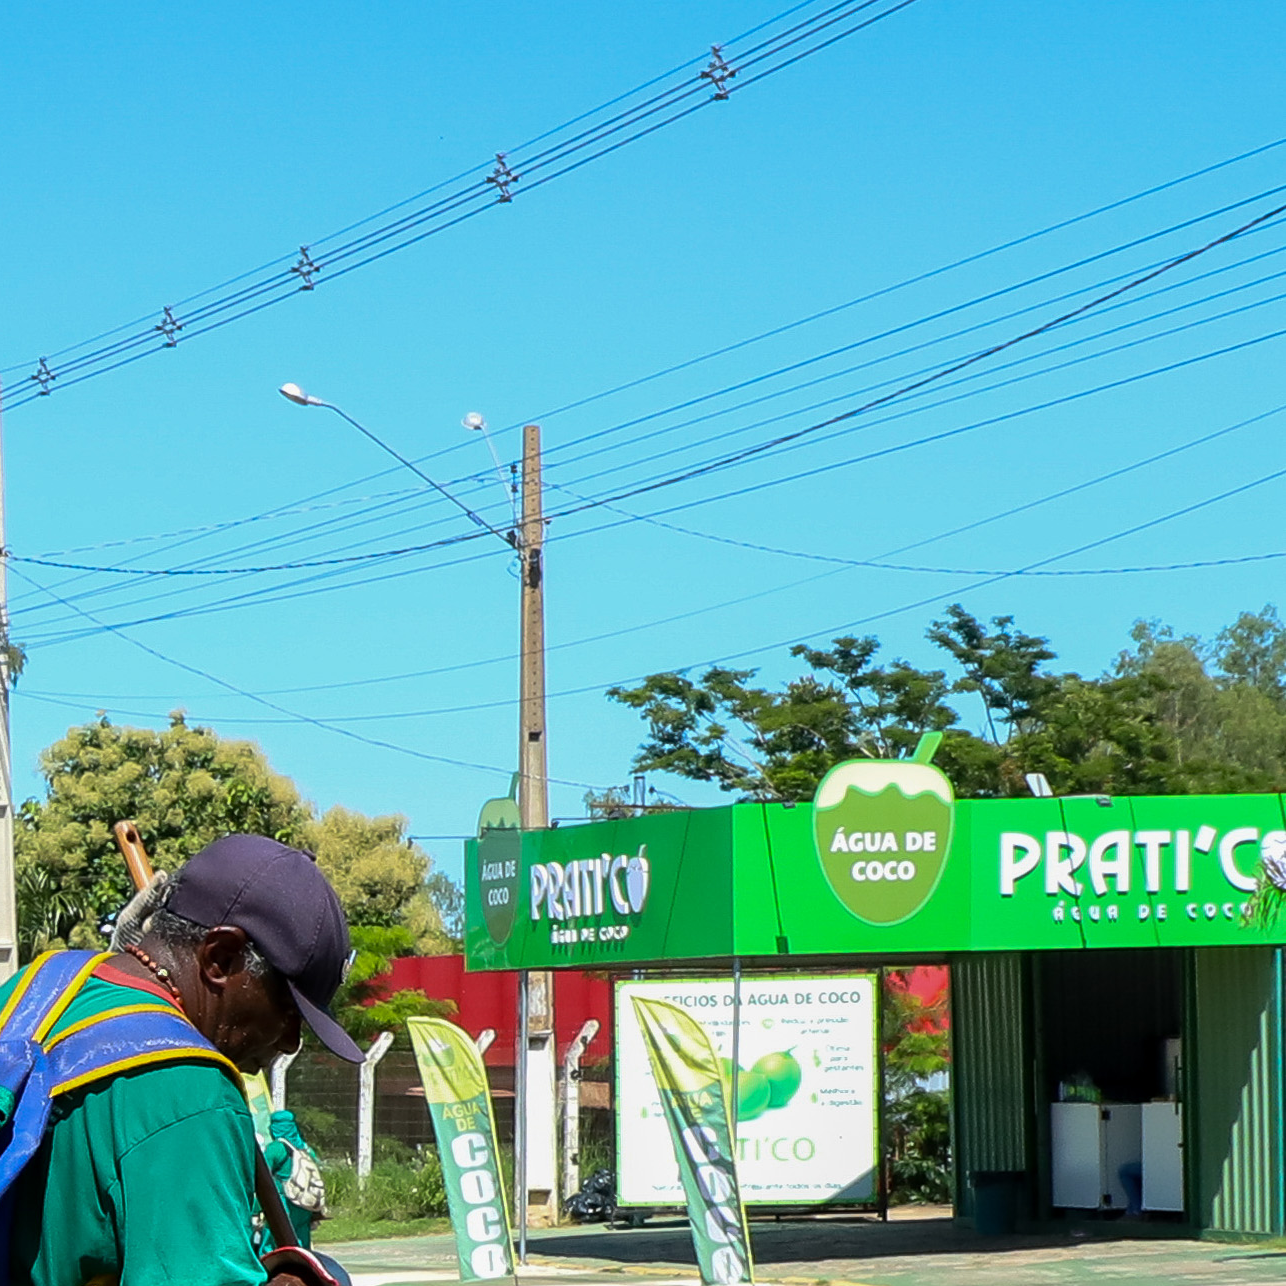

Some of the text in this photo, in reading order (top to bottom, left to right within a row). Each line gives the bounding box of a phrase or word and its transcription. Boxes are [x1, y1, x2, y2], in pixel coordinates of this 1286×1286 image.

[830, 826, 936, 852] ÁGUA DE
[481, 859, 517, 882] ÁGUA DE
[851, 860, 916, 881] COCO
[488, 886, 509, 906] COCO
[1052, 900, 1255, 923] ÁGUA DE COCO
[599, 925, 629, 941] COCO
[794, 992, 813, 1005] DE
[818, 990, 861, 1004] COCO
[455, 1116, 476, 1132] DE
[737, 1136, 816, 1162] TI'CO
[451, 1132, 507, 1279] COCO
